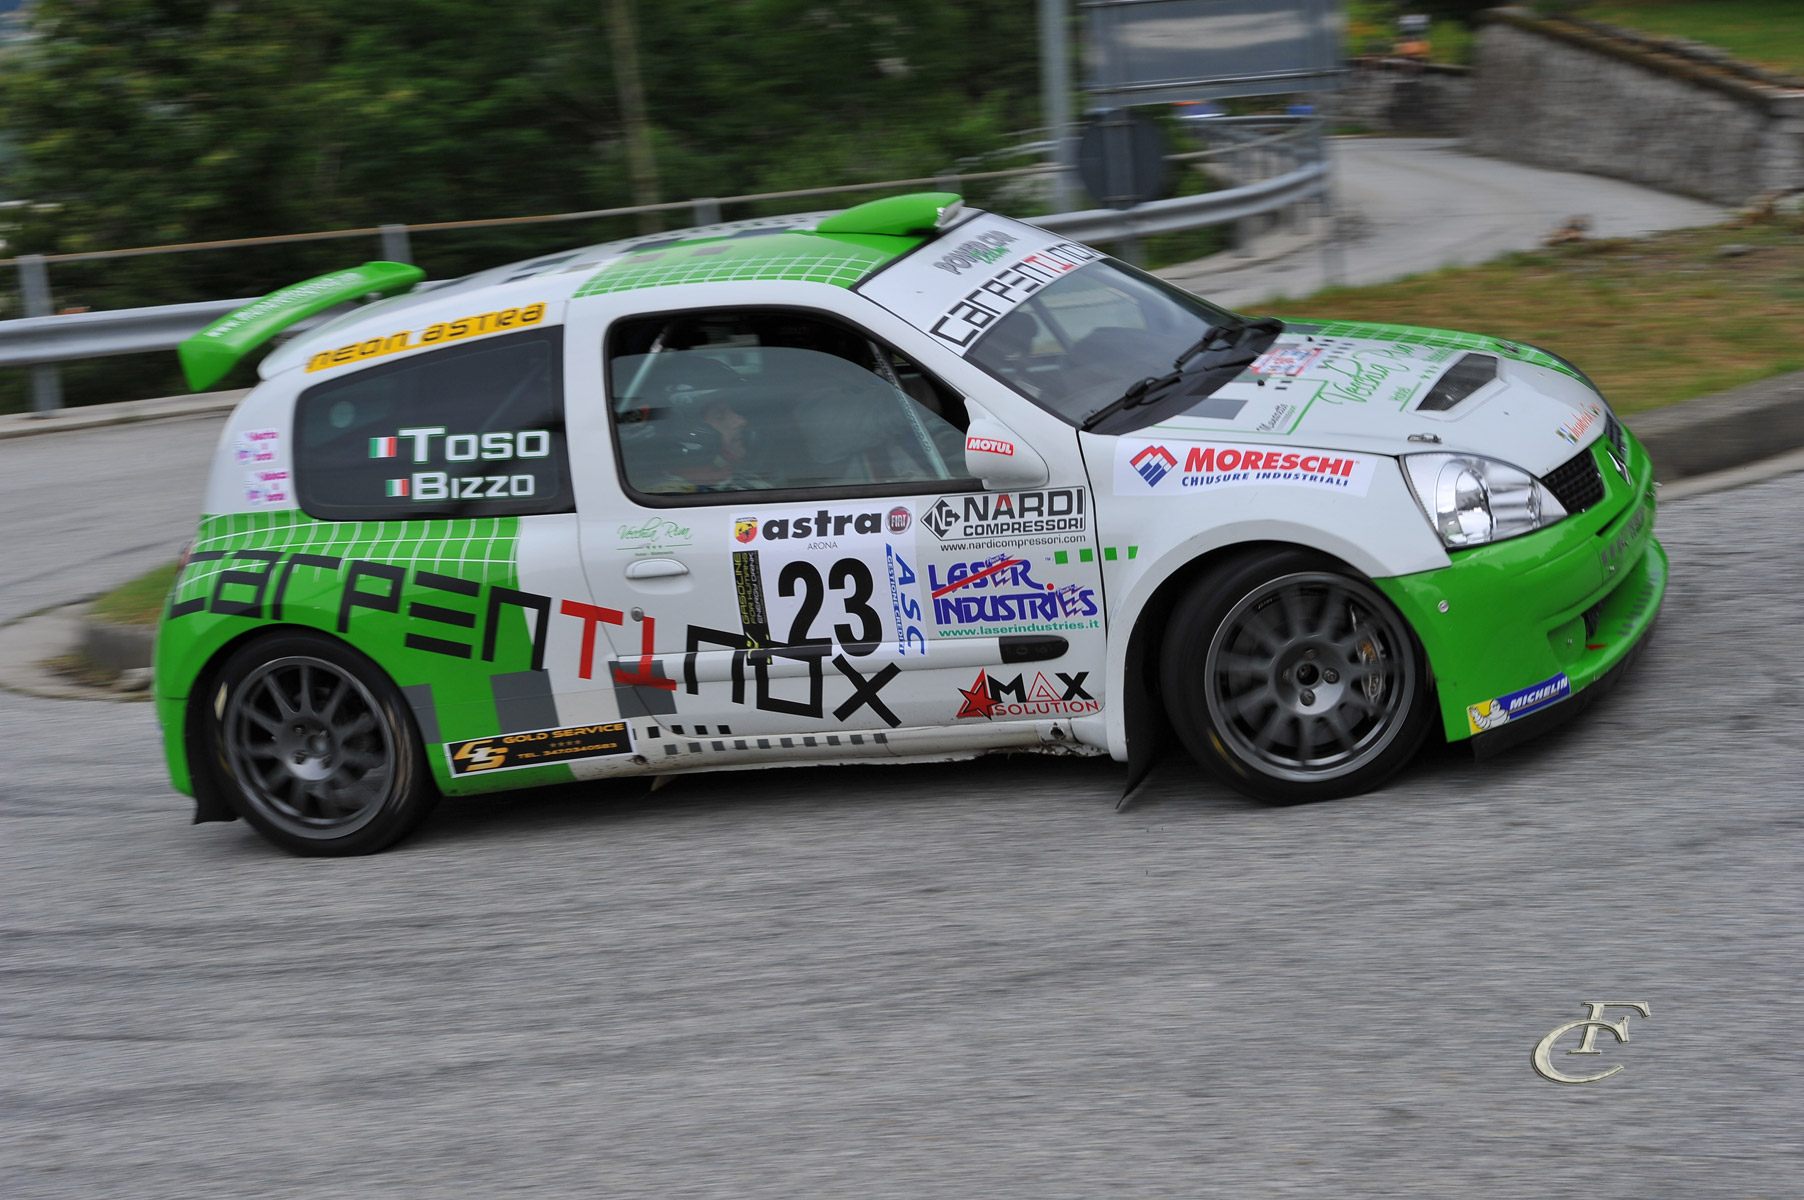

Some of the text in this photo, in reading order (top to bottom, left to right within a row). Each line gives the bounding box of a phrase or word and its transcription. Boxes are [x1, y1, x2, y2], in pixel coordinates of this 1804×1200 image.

[968, 438, 1012, 454] MOTUL
[1184, 447, 1355, 478] MORESCHI
[1181, 471, 1349, 487] CHIUSURE INDUSTRIALI
[890, 514, 907, 528] FIAT
[963, 489, 1084, 523] NARDI
[762, 510, 882, 541] astra
[963, 517, 1084, 537] COMPRESSORI
[807, 541, 838, 551] ARONA
[940, 534, 1086, 552] www.nardicompressori.com
[741, 553, 754, 601] HUMANS
[748, 552, 756, 582] DRINK
[927, 554, 1045, 594] LASER
[733, 552, 750, 625] GASOLINE
[752, 583, 764, 624] ENERGY
[895, 552, 926, 656] ASC
[778, 557, 883, 656] 23
[932, 583, 1098, 626] INDUSTRIES
[938, 619, 1101, 637] www.laserindustries.it
[993, 700, 1100, 716] SOLUTION
[1509, 675, 1568, 711] MICHELIN
[502, 723, 625, 744] GOLD SERVICE
